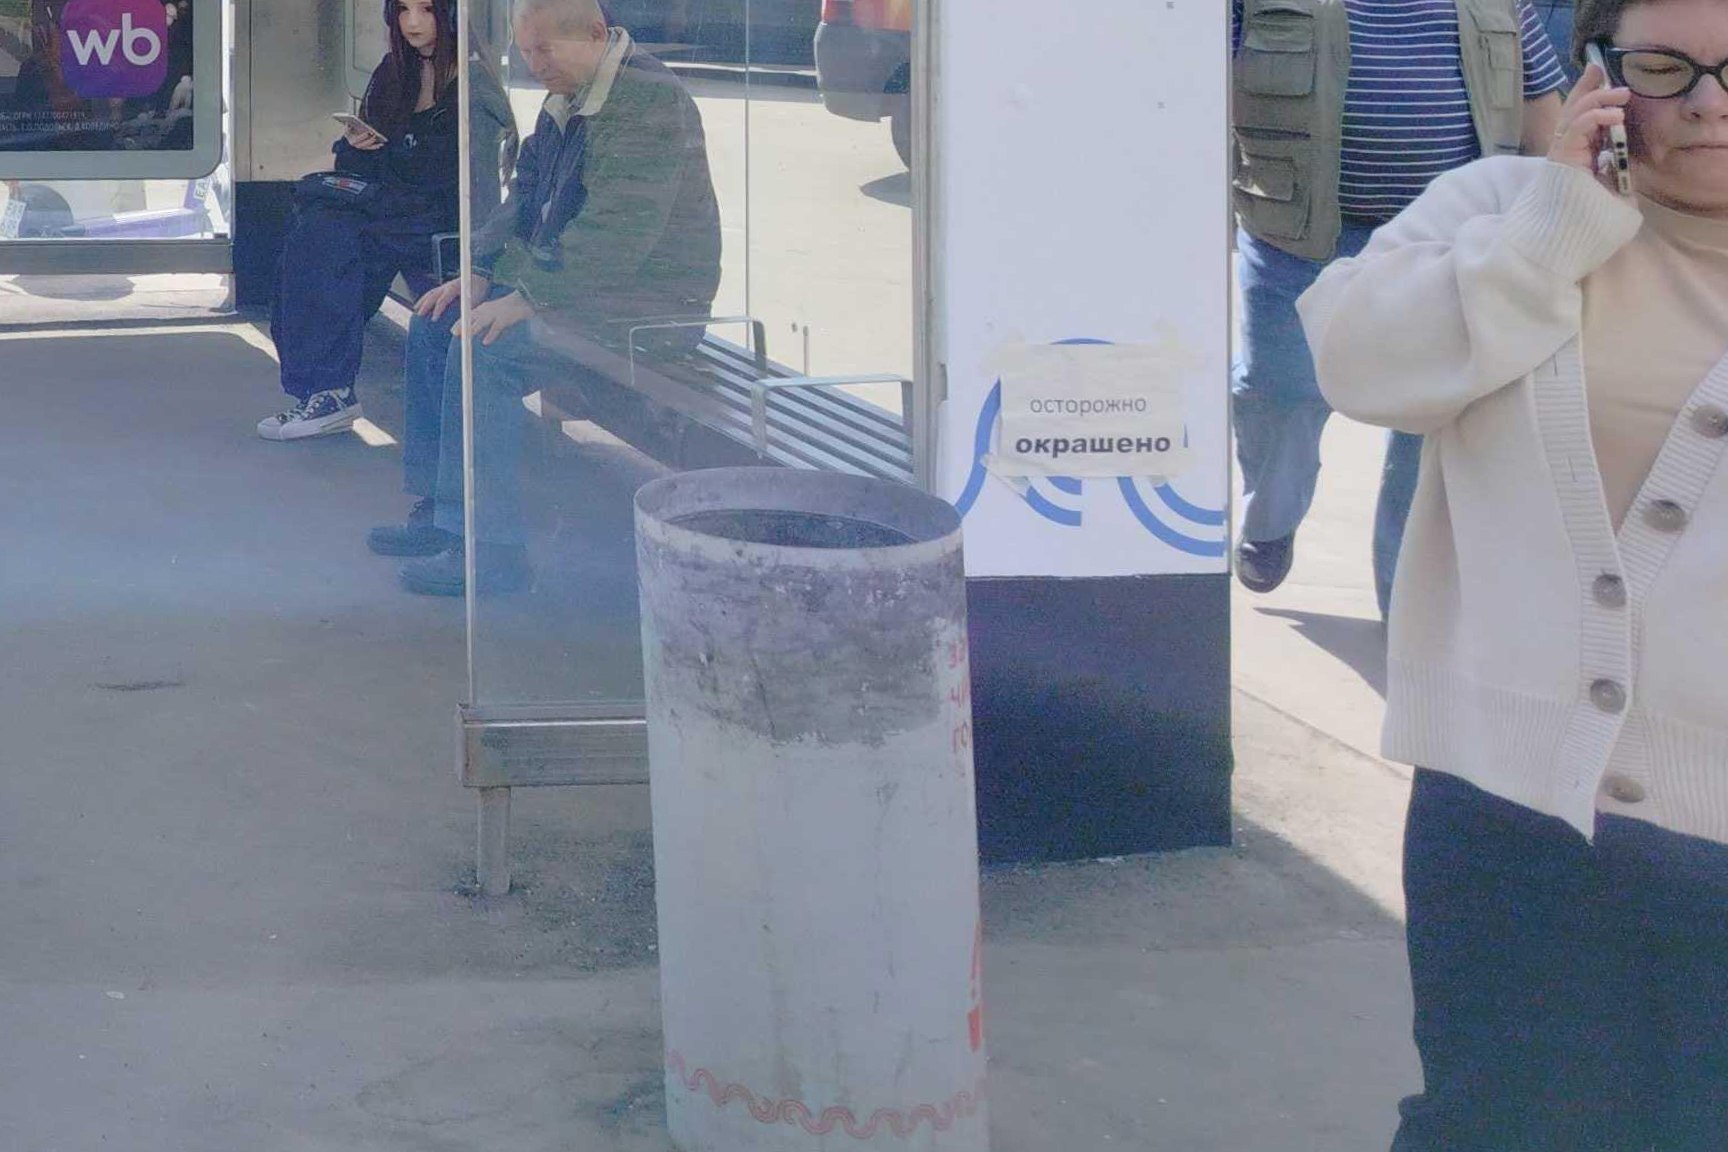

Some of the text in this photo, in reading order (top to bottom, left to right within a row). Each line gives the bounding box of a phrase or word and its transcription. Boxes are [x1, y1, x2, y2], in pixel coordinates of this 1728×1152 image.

[66, 12, 161, 66] wb
[1030, 398, 1147, 417] осторожно
[1015, 436, 1171, 459] окрашено
